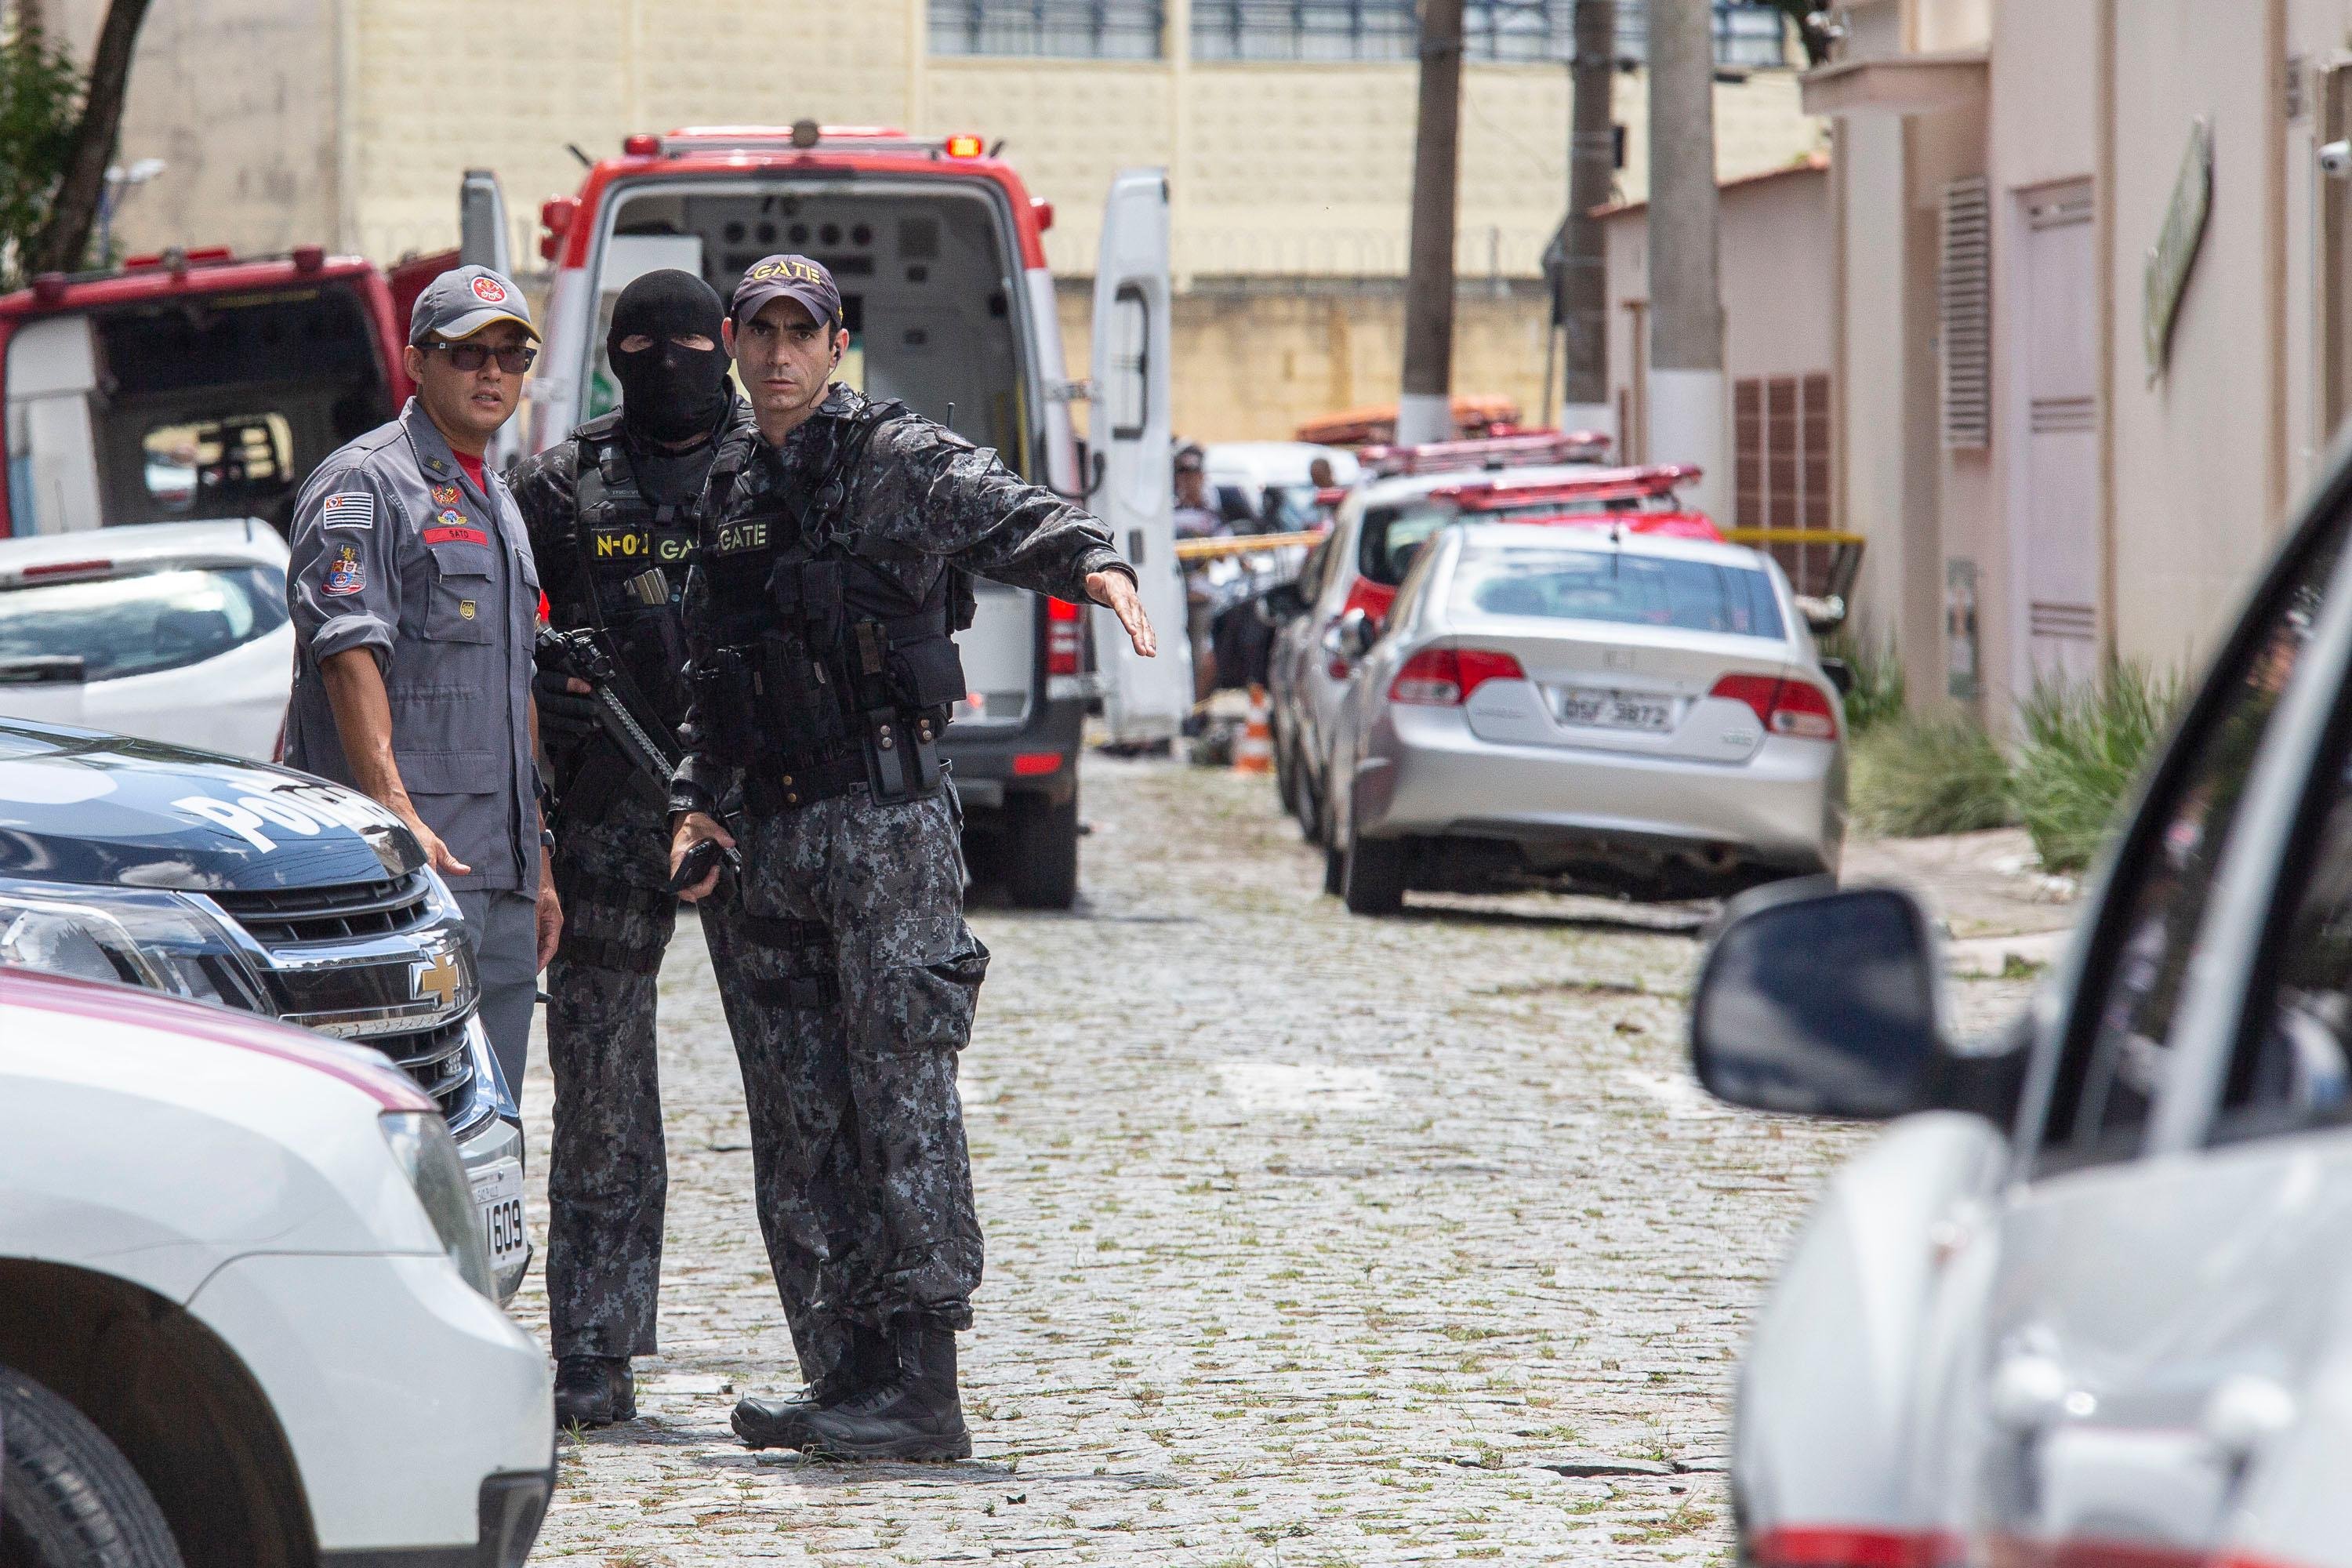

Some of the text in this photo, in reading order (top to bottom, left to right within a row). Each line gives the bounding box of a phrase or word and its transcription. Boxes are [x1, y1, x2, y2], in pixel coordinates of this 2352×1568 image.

[753, 260, 821, 285] GATE
[448, 530, 470, 539] SATO
[718, 523, 767, 552] GATE
